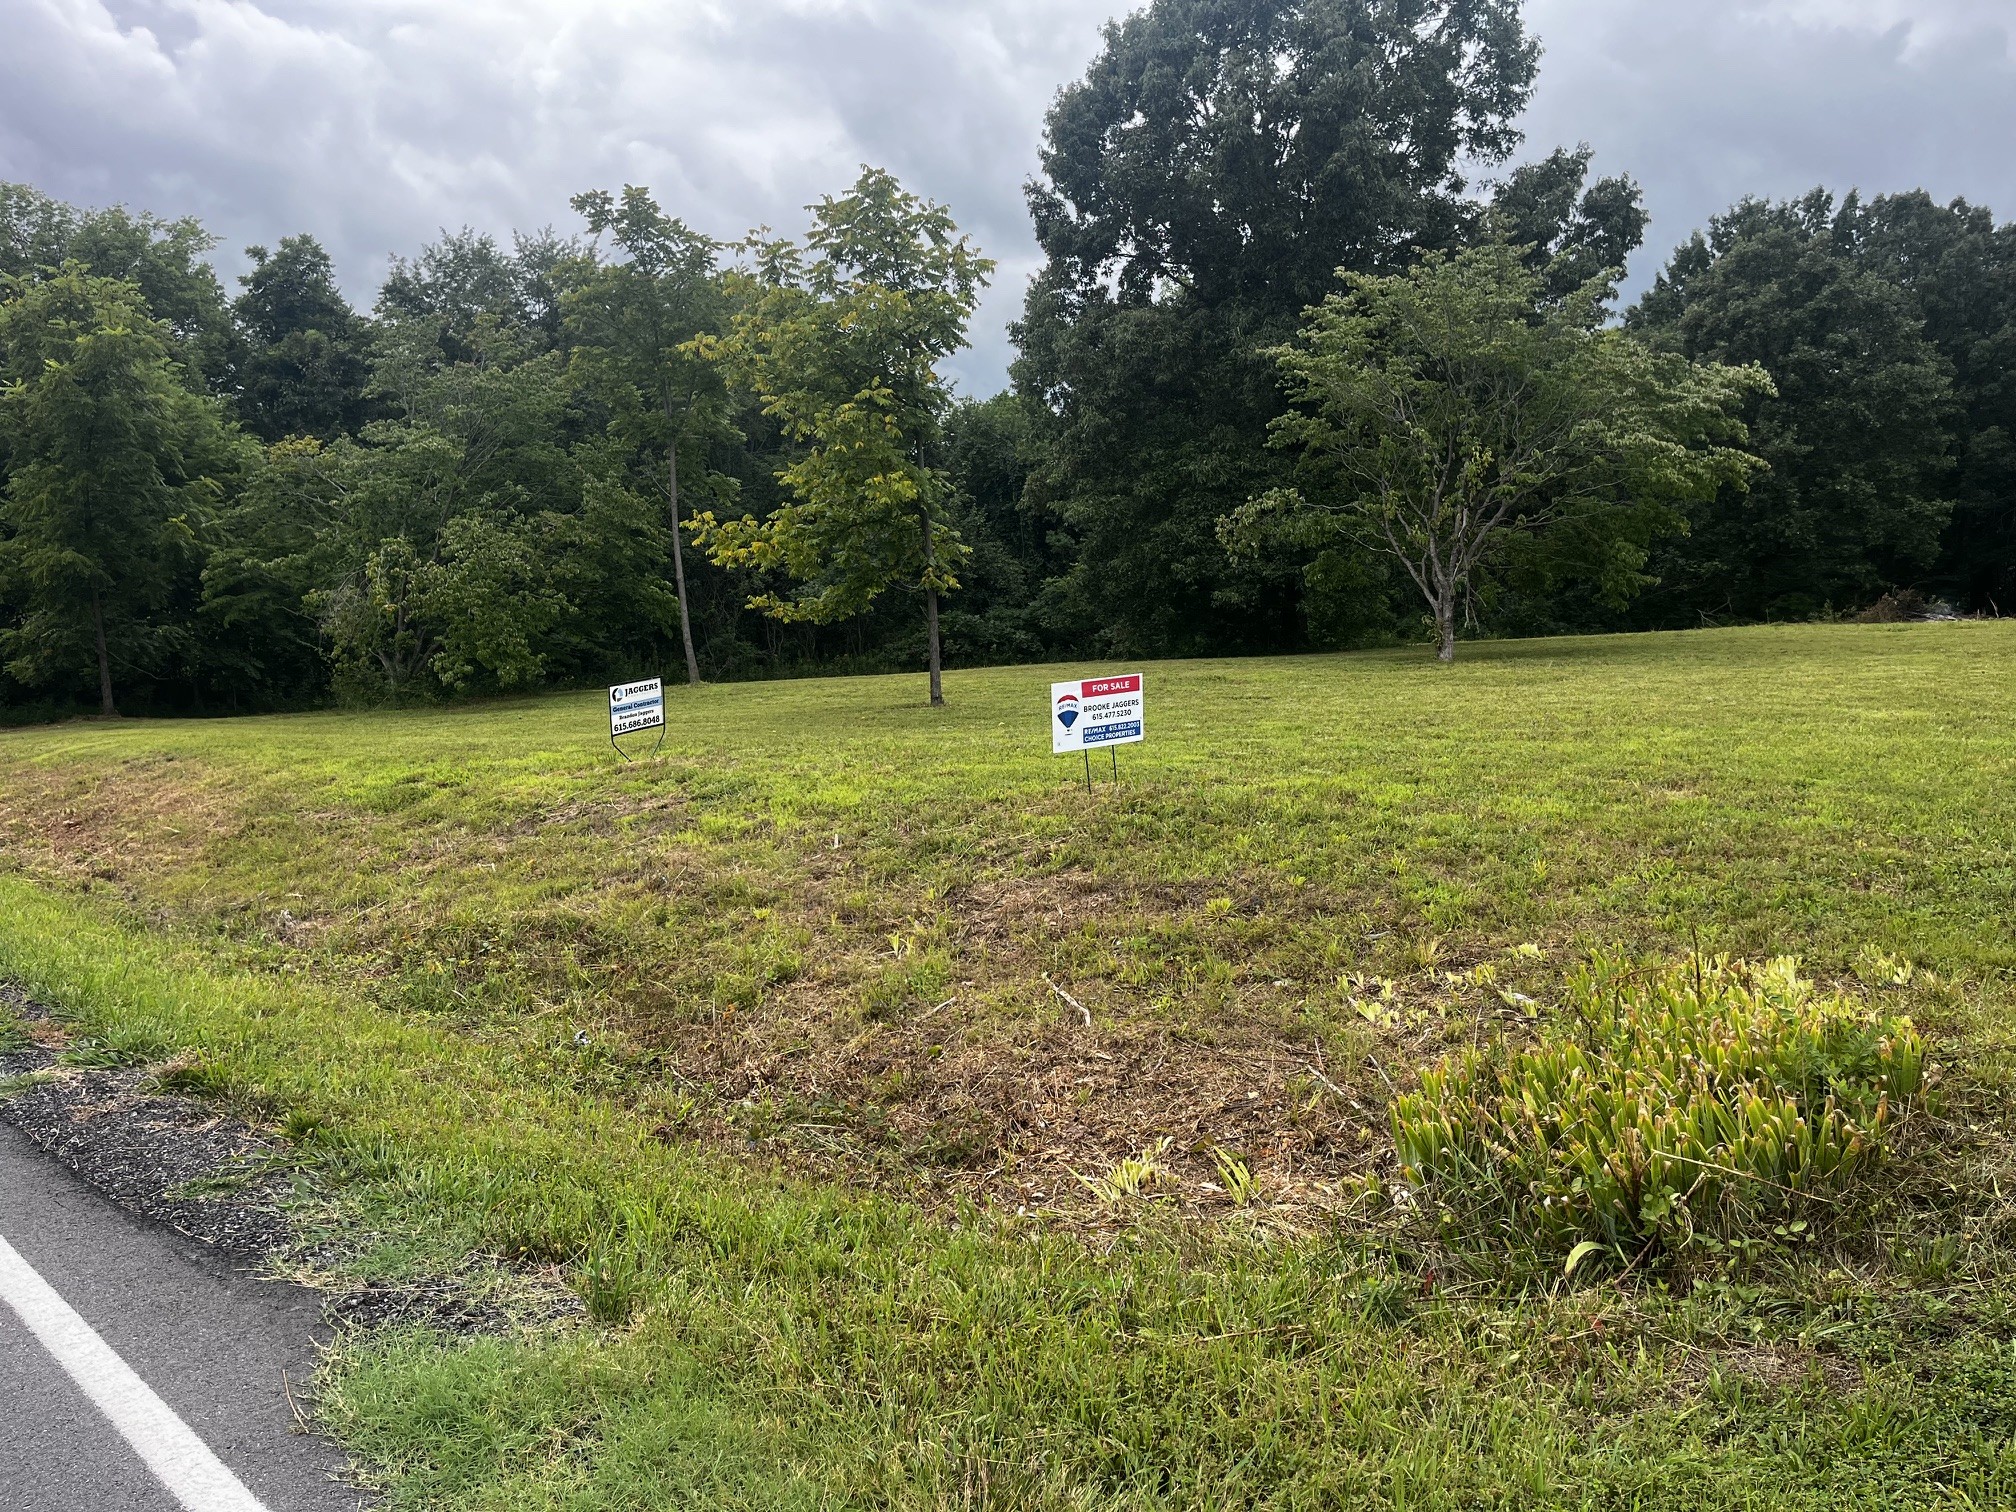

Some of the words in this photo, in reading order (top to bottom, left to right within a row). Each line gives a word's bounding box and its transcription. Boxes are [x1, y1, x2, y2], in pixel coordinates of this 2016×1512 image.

[625, 683, 658, 697] JAGGERS
[1092, 684, 1109, 692] FOR
[1110, 681, 1130, 690] SALE
[613, 703, 633, 712] General
[634, 699, 659, 708] Contractor
[1083, 703, 1110, 712] BROOKE
[1111, 699, 1139, 708] JAGGERS
[1092, 709, 1132, 720] 615.477.5230
[614, 715, 660, 731] 615.686.8048
[1084, 726, 1106, 734] RE/MAX
[1084, 734, 1105, 742] CHOICE
[1105, 729, 1136, 739] PROPERTIES
